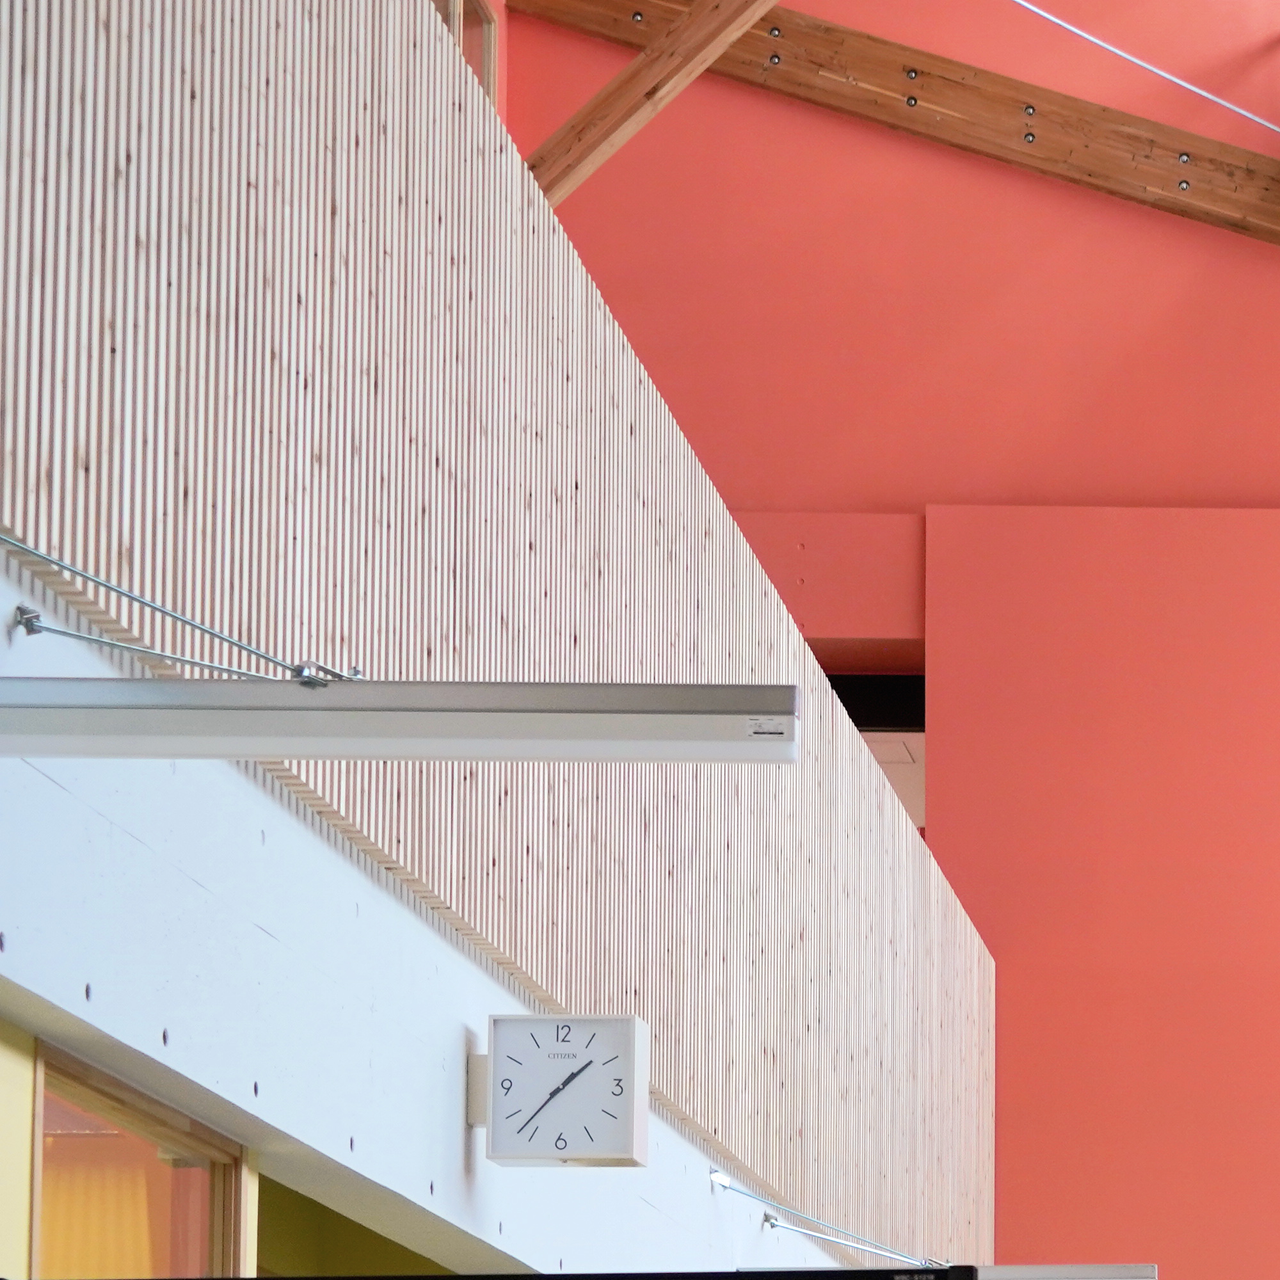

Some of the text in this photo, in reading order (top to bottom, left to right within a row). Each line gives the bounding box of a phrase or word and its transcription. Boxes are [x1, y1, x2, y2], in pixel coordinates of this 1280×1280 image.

[556, 1024, 571, 1043] 12
[500, 1078, 513, 1096] 9
[611, 1078, 624, 1097] 3
[554, 1132, 568, 1150] 6
